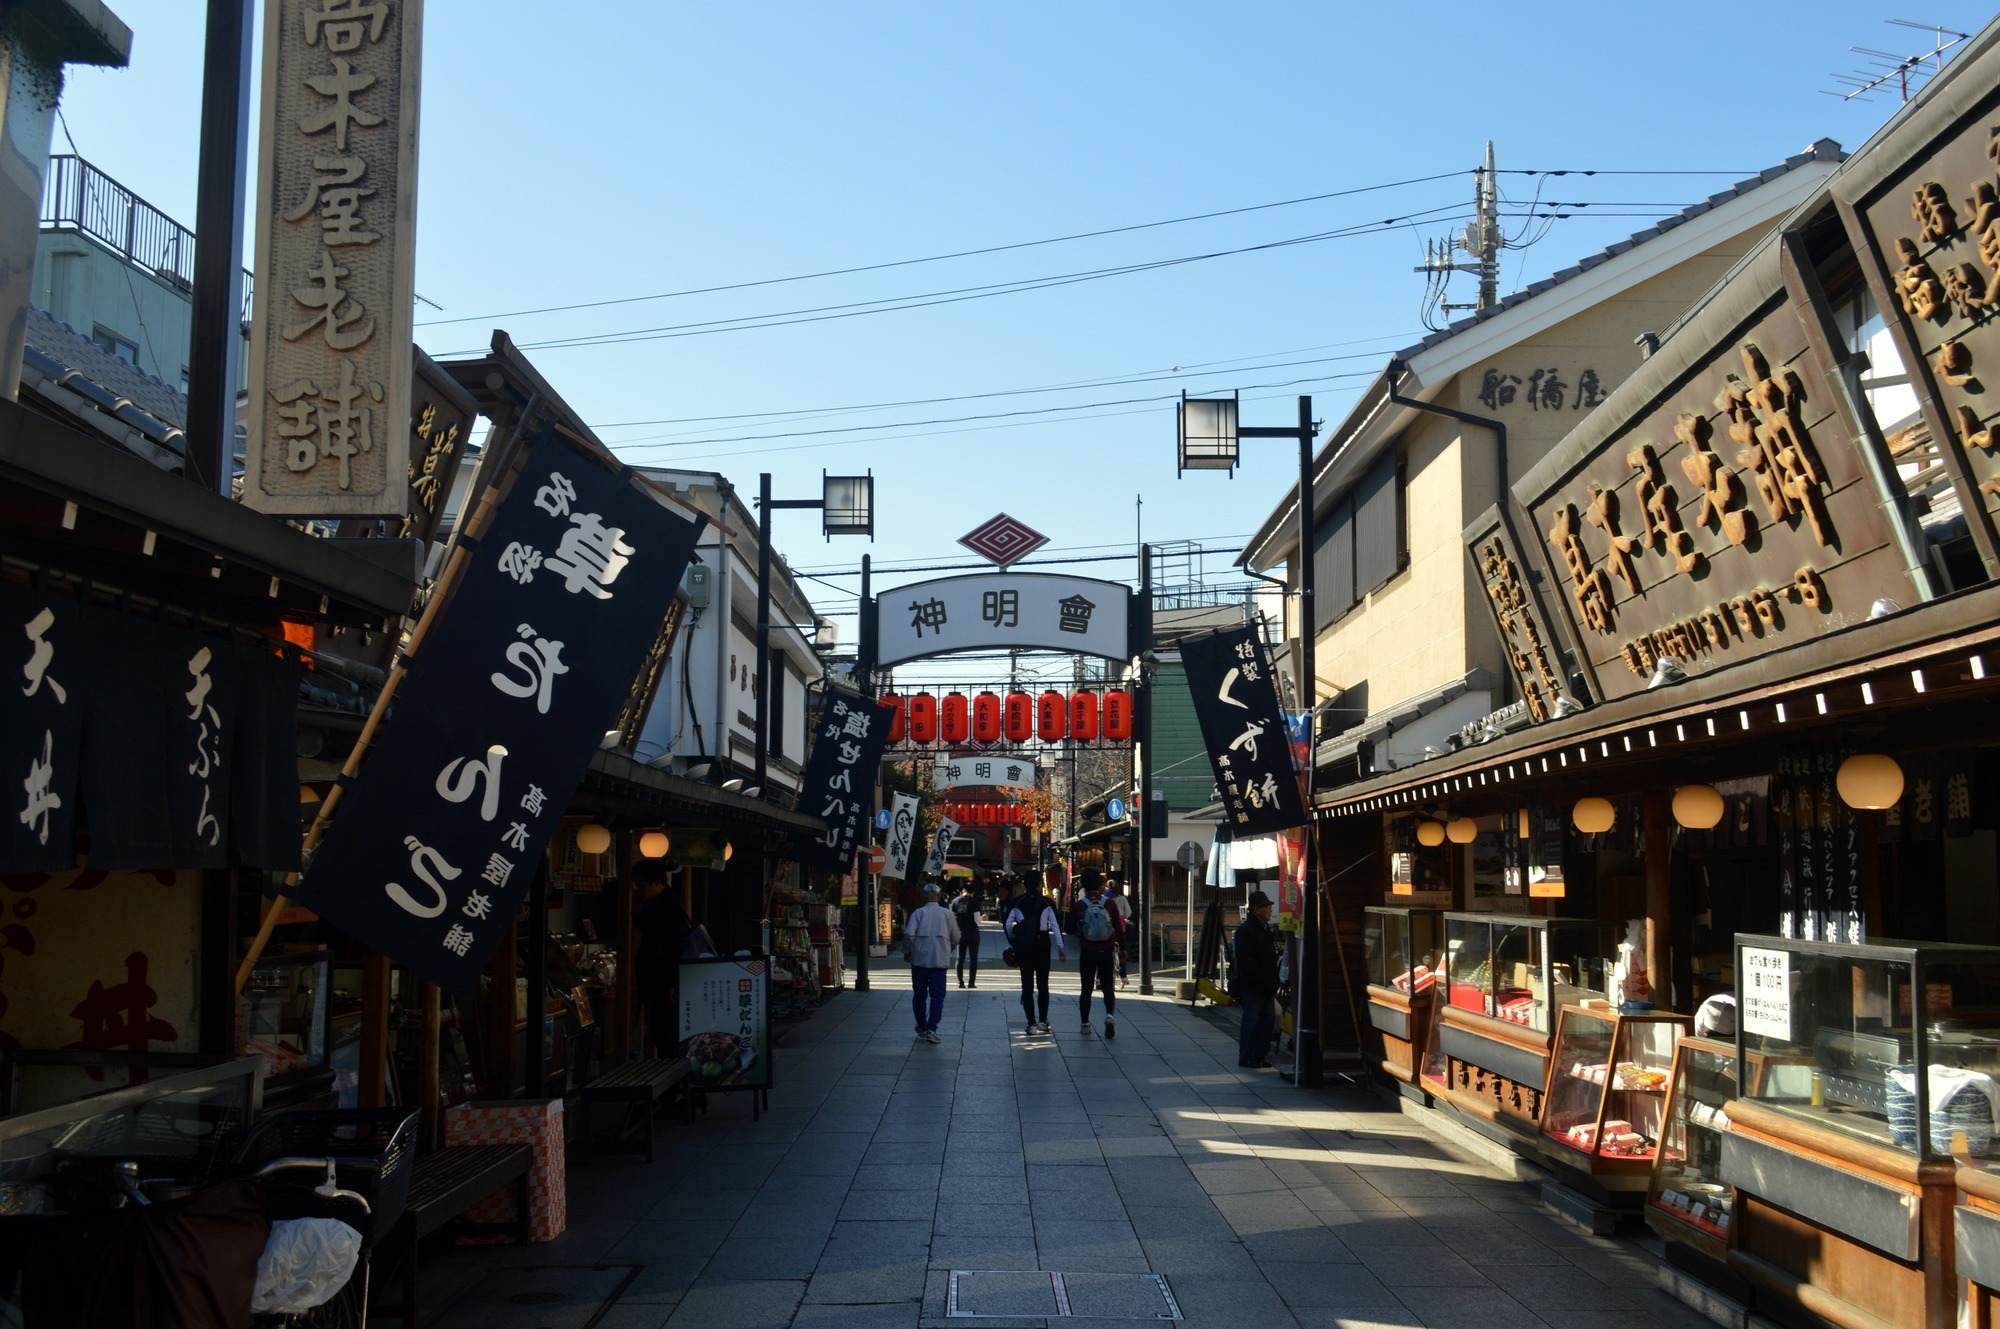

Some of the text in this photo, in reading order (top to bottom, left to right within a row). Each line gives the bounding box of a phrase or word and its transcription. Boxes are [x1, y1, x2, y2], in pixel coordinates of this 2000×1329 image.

[1477, 368, 1607, 411] 船橋屋
[908, 589, 1096, 638] 神明會
[1234, 638, 1262, 682] 特製
[185, 645, 222, 848] 天ぷら
[1217, 667, 1281, 810] くず餅
[1750, 955, 1781, 969] おでん食べ歩き
[738, 993, 752, 1049] 草だんご
